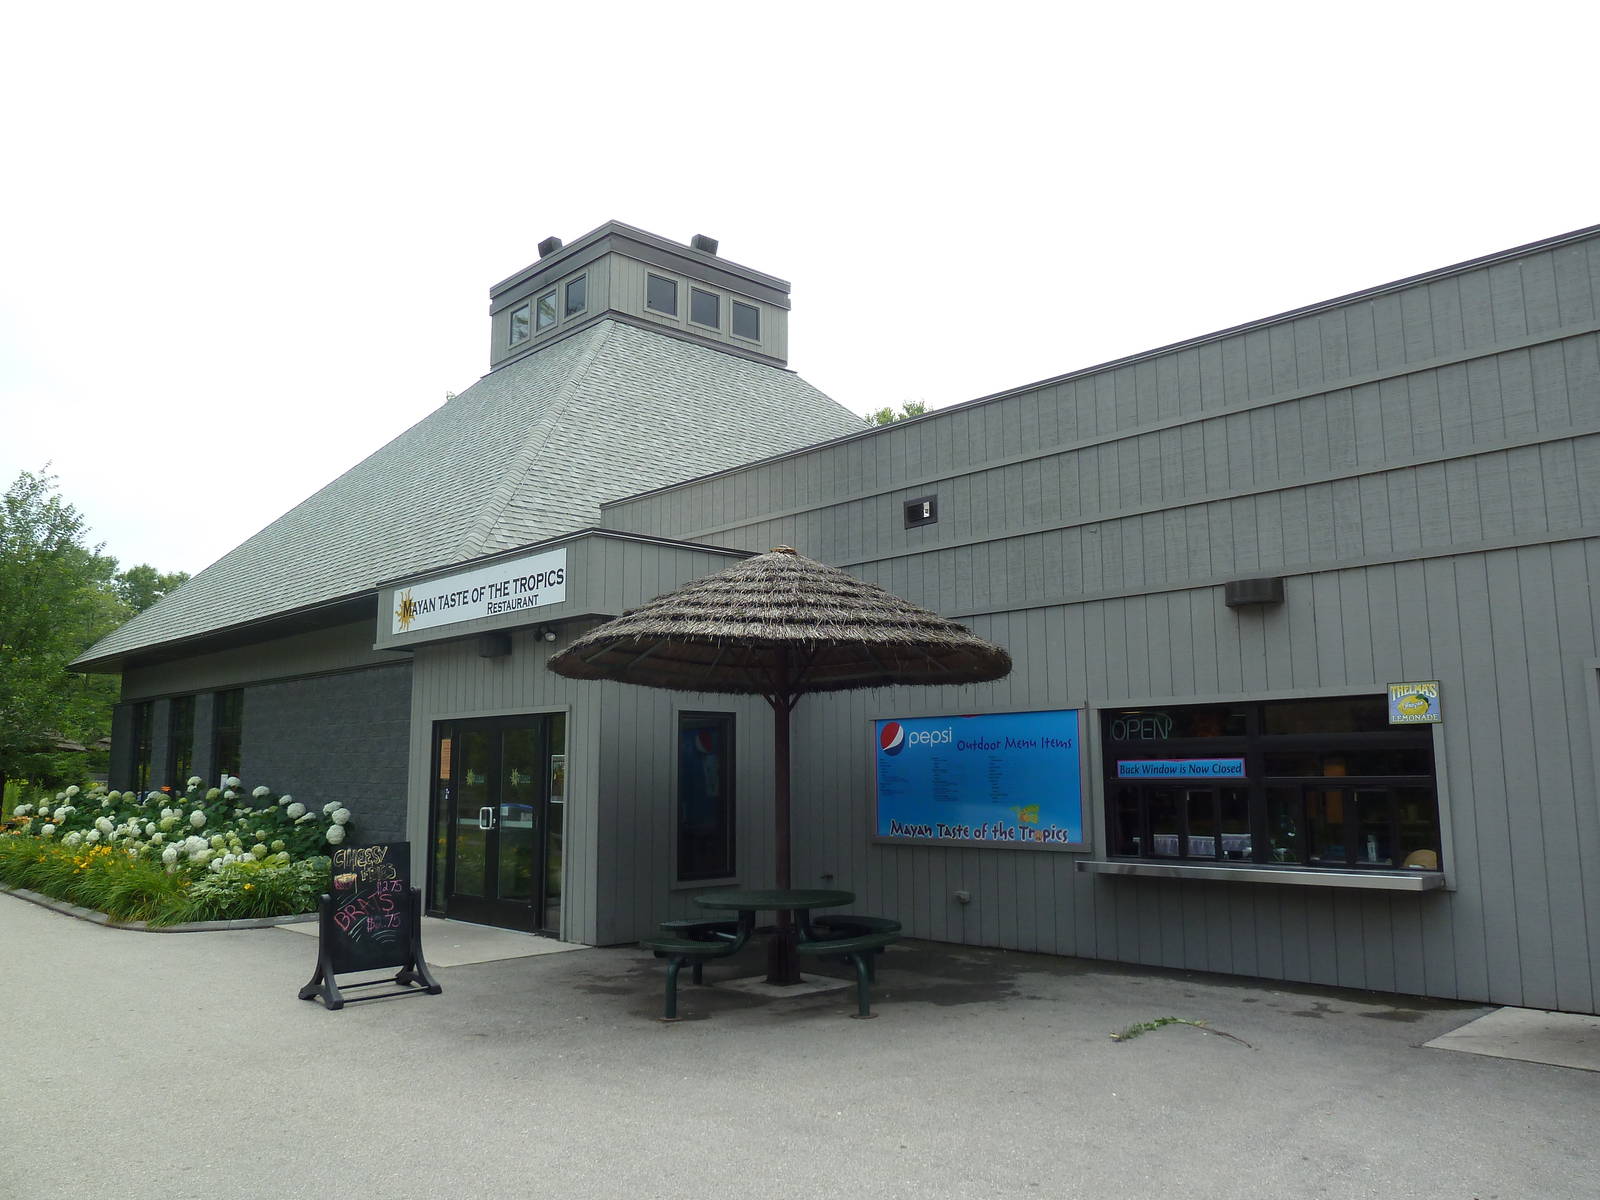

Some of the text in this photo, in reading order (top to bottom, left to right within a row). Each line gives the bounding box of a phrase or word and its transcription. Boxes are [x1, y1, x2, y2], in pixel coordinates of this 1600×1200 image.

[403, 568, 565, 618] MAYAN TASTE OF THE TROPICS
[486, 594, 539, 615] RESTAURANT
[1392, 713, 1438, 722] LEMONADE
[908, 727, 953, 748] pepsi
[1111, 718, 1169, 741] OPEN
[956, 736, 1073, 752] Outdoor Menu Items
[1120, 763, 1242, 775] Back Window is Now Closed
[889, 819, 1069, 843] Mayan Taste of the Tropics
